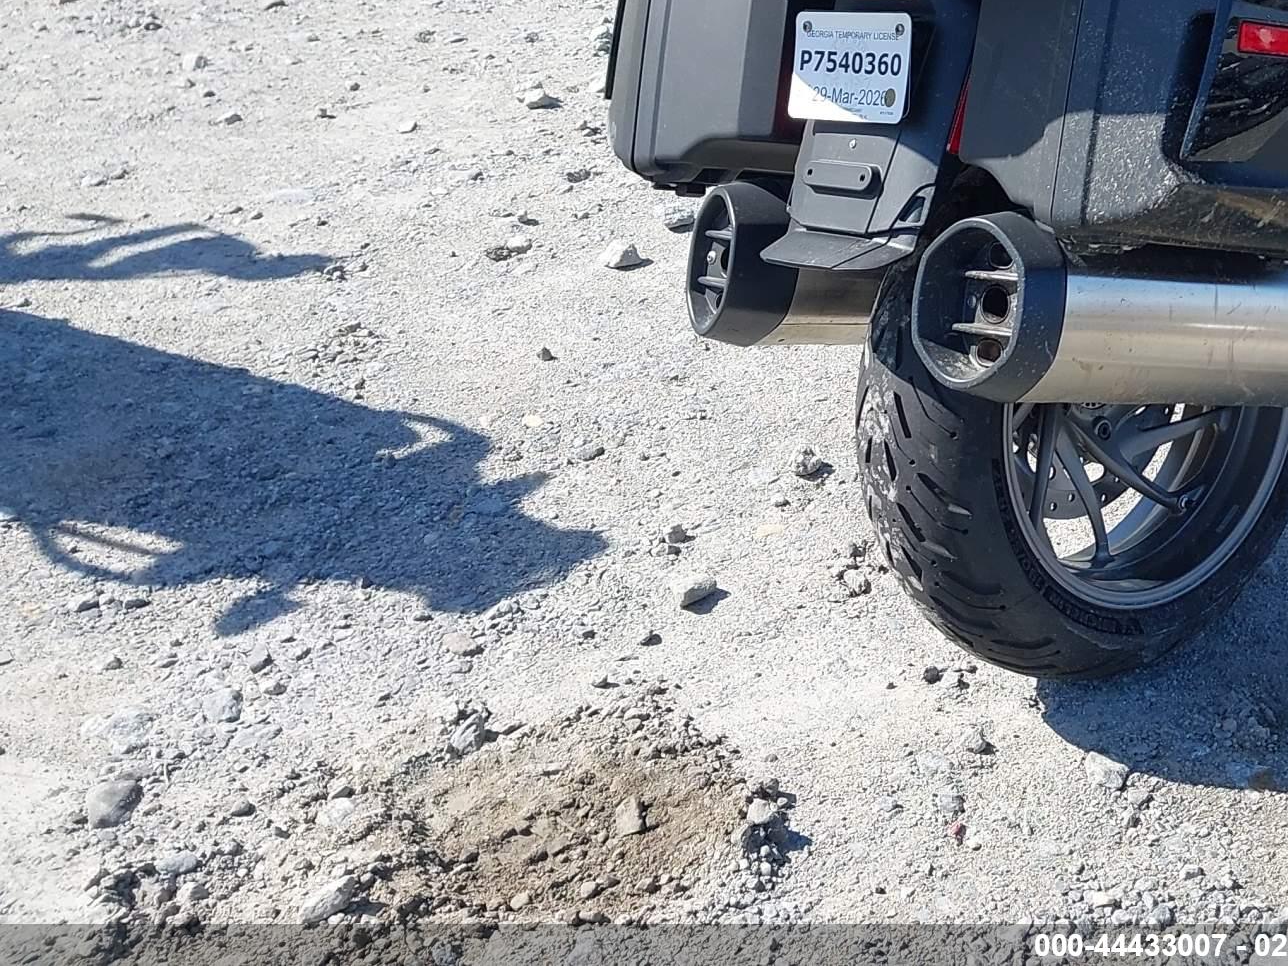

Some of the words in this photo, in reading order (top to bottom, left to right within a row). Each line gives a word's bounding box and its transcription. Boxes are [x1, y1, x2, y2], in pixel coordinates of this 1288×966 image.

[806, 29, 834, 38] GEORGIA
[835, 31, 872, 40] TEMPORARY
[799, 50, 902, 76] P7540360
